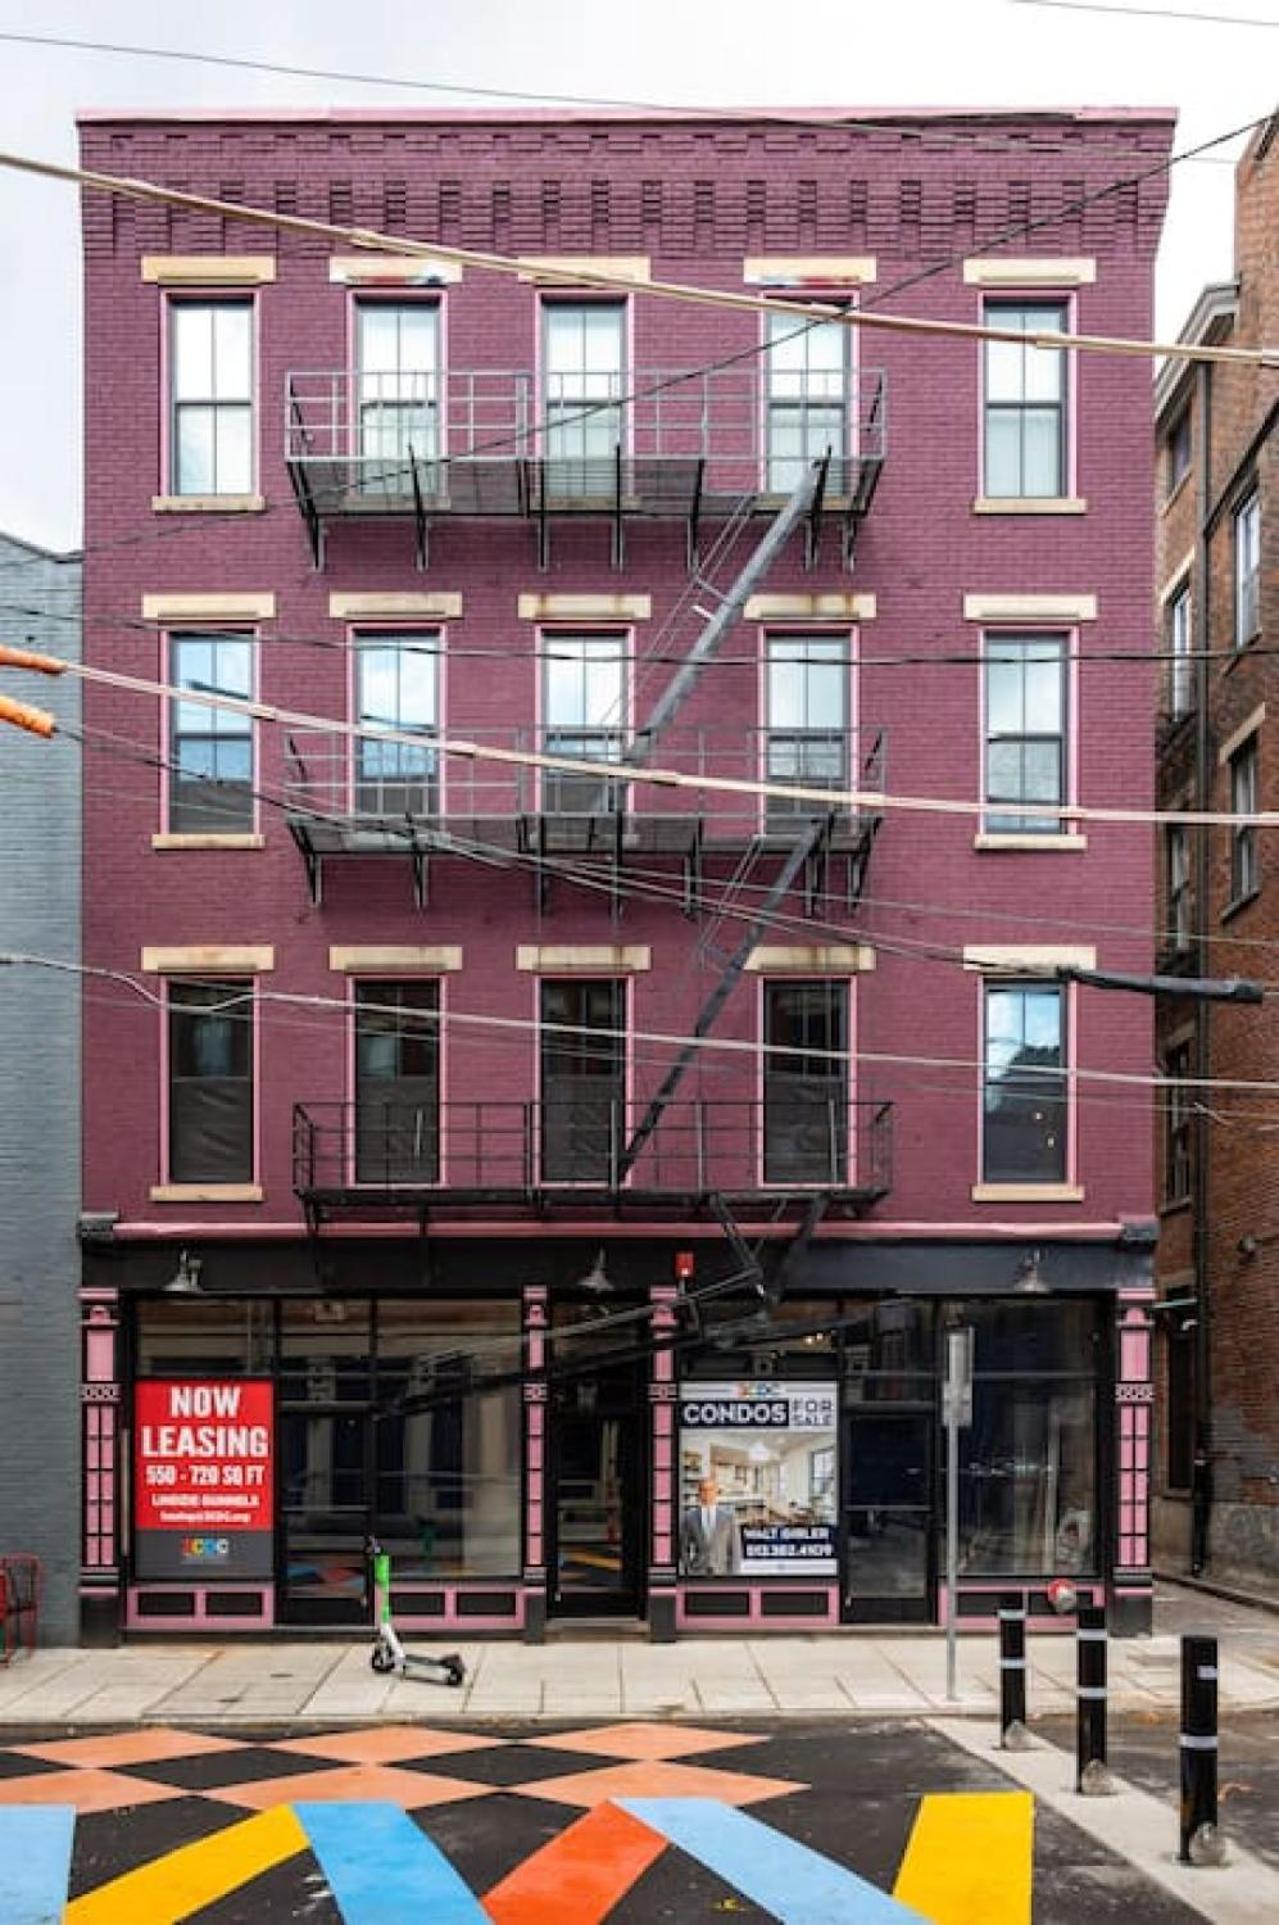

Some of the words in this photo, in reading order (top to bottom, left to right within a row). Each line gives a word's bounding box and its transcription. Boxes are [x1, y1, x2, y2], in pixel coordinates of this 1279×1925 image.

[171, 1386, 240, 1418] NOW
[684, 1403, 786, 1424] CONDOS
[142, 1426, 269, 1457] LEASING
[222, 1464, 243, 1487] SQ
[245, 1464, 265, 1486] FT
